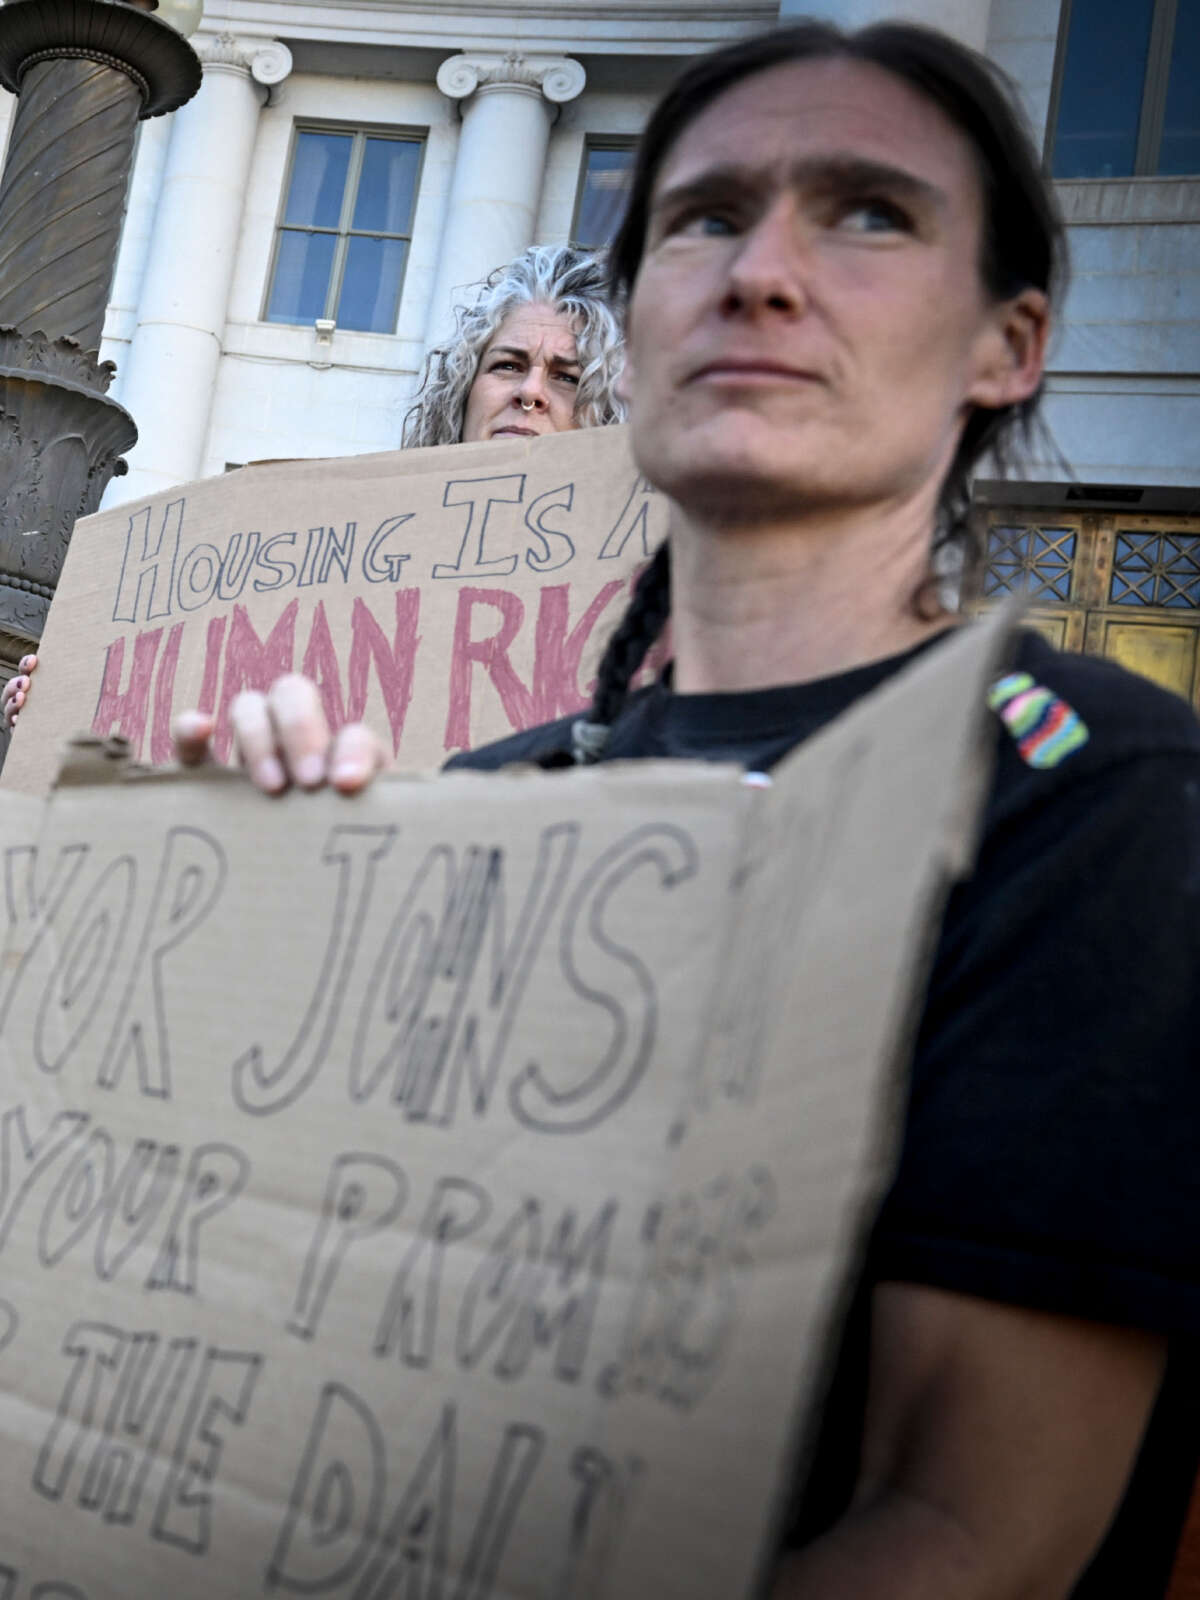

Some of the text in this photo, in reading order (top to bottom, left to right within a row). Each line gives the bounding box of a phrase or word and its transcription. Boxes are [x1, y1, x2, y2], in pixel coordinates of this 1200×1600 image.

[91, 577, 650, 765] HUMAN RIG
[33, 1322, 266, 1557] THE
